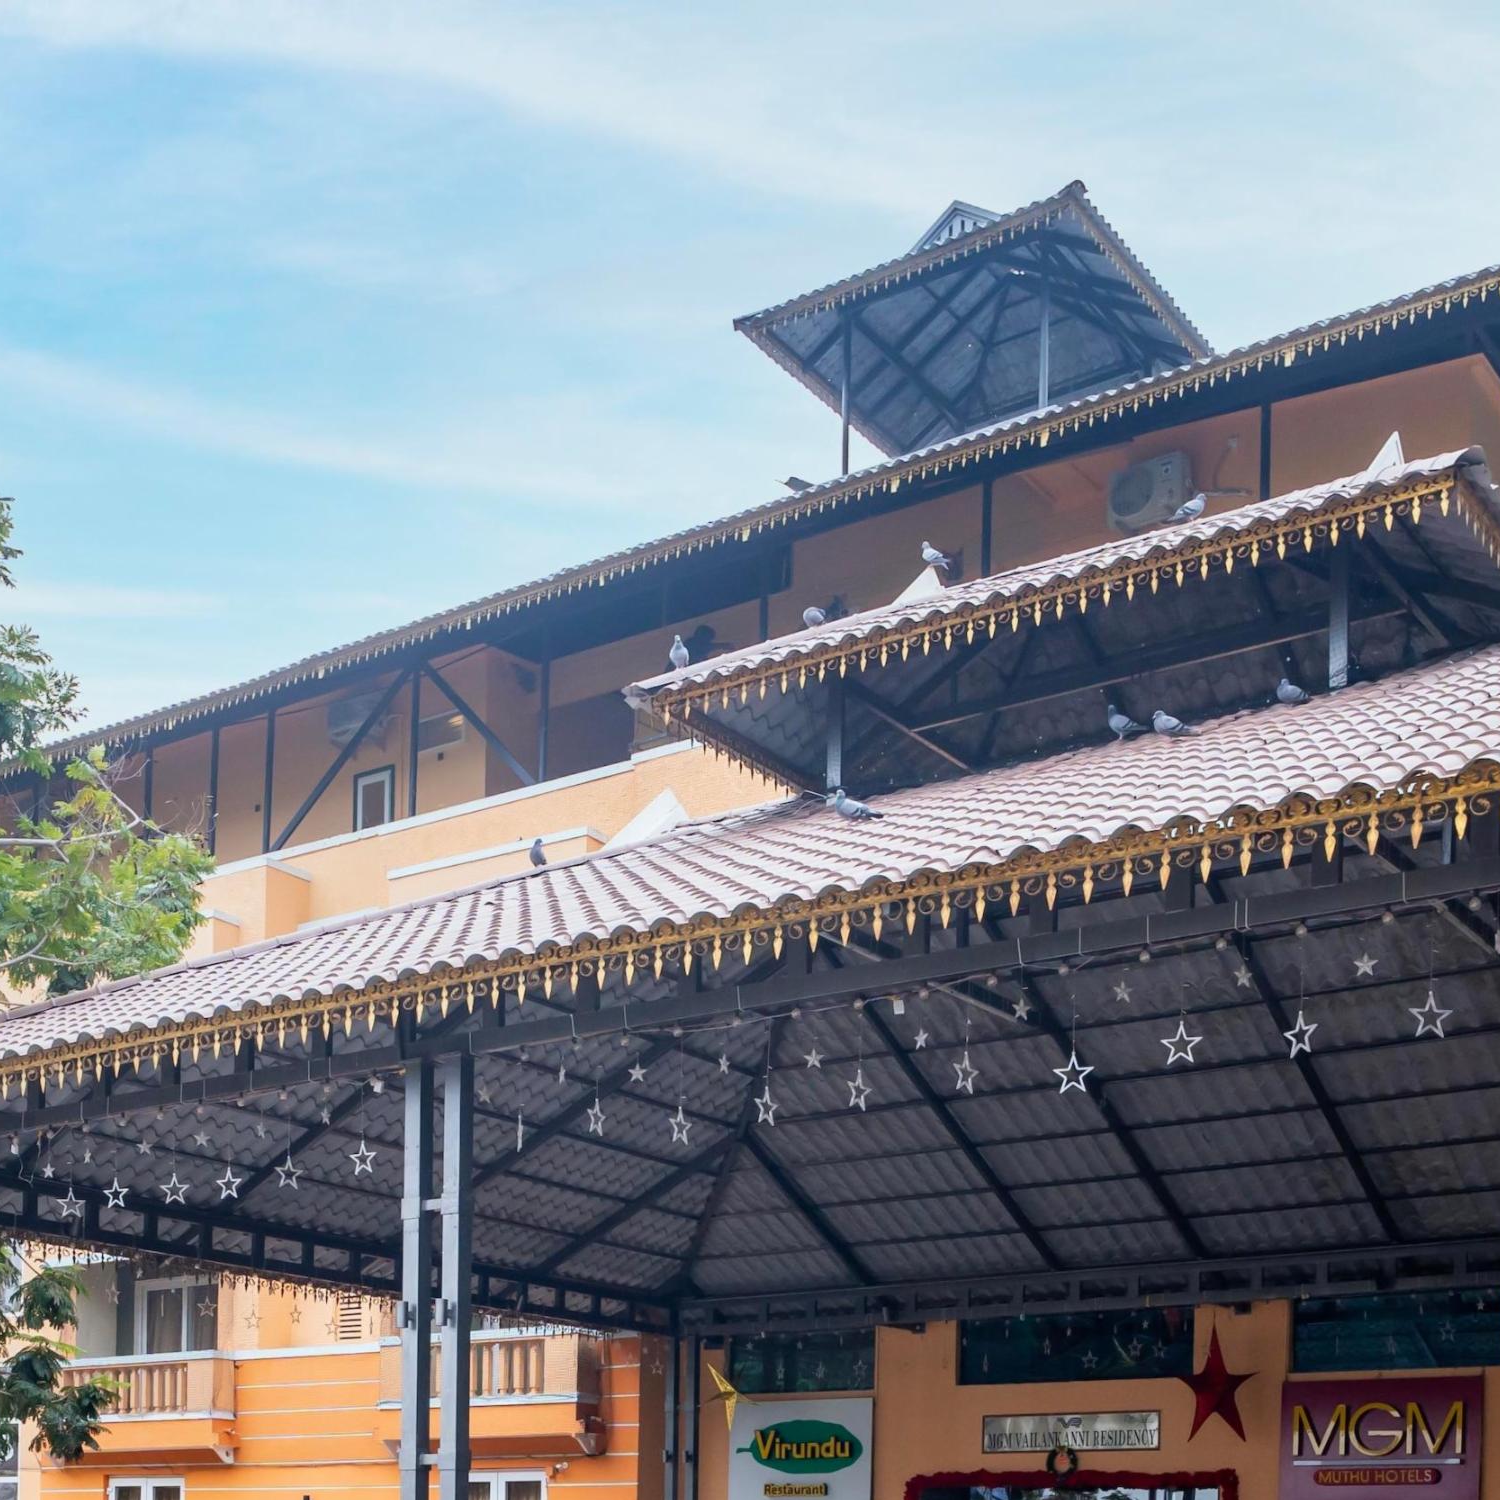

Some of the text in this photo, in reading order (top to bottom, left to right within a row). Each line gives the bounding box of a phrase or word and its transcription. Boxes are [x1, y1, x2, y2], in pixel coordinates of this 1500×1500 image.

[987, 1432, 1012, 1449] MGM
[1093, 1428, 1157, 1447] RESIDENCY
[1293, 1401, 1464, 1457] MGM
[755, 1430, 850, 1460] Virundu
[1318, 1470, 1433, 1484] MUTHU HOTELS
[764, 1484, 825, 1497] Restaurant
